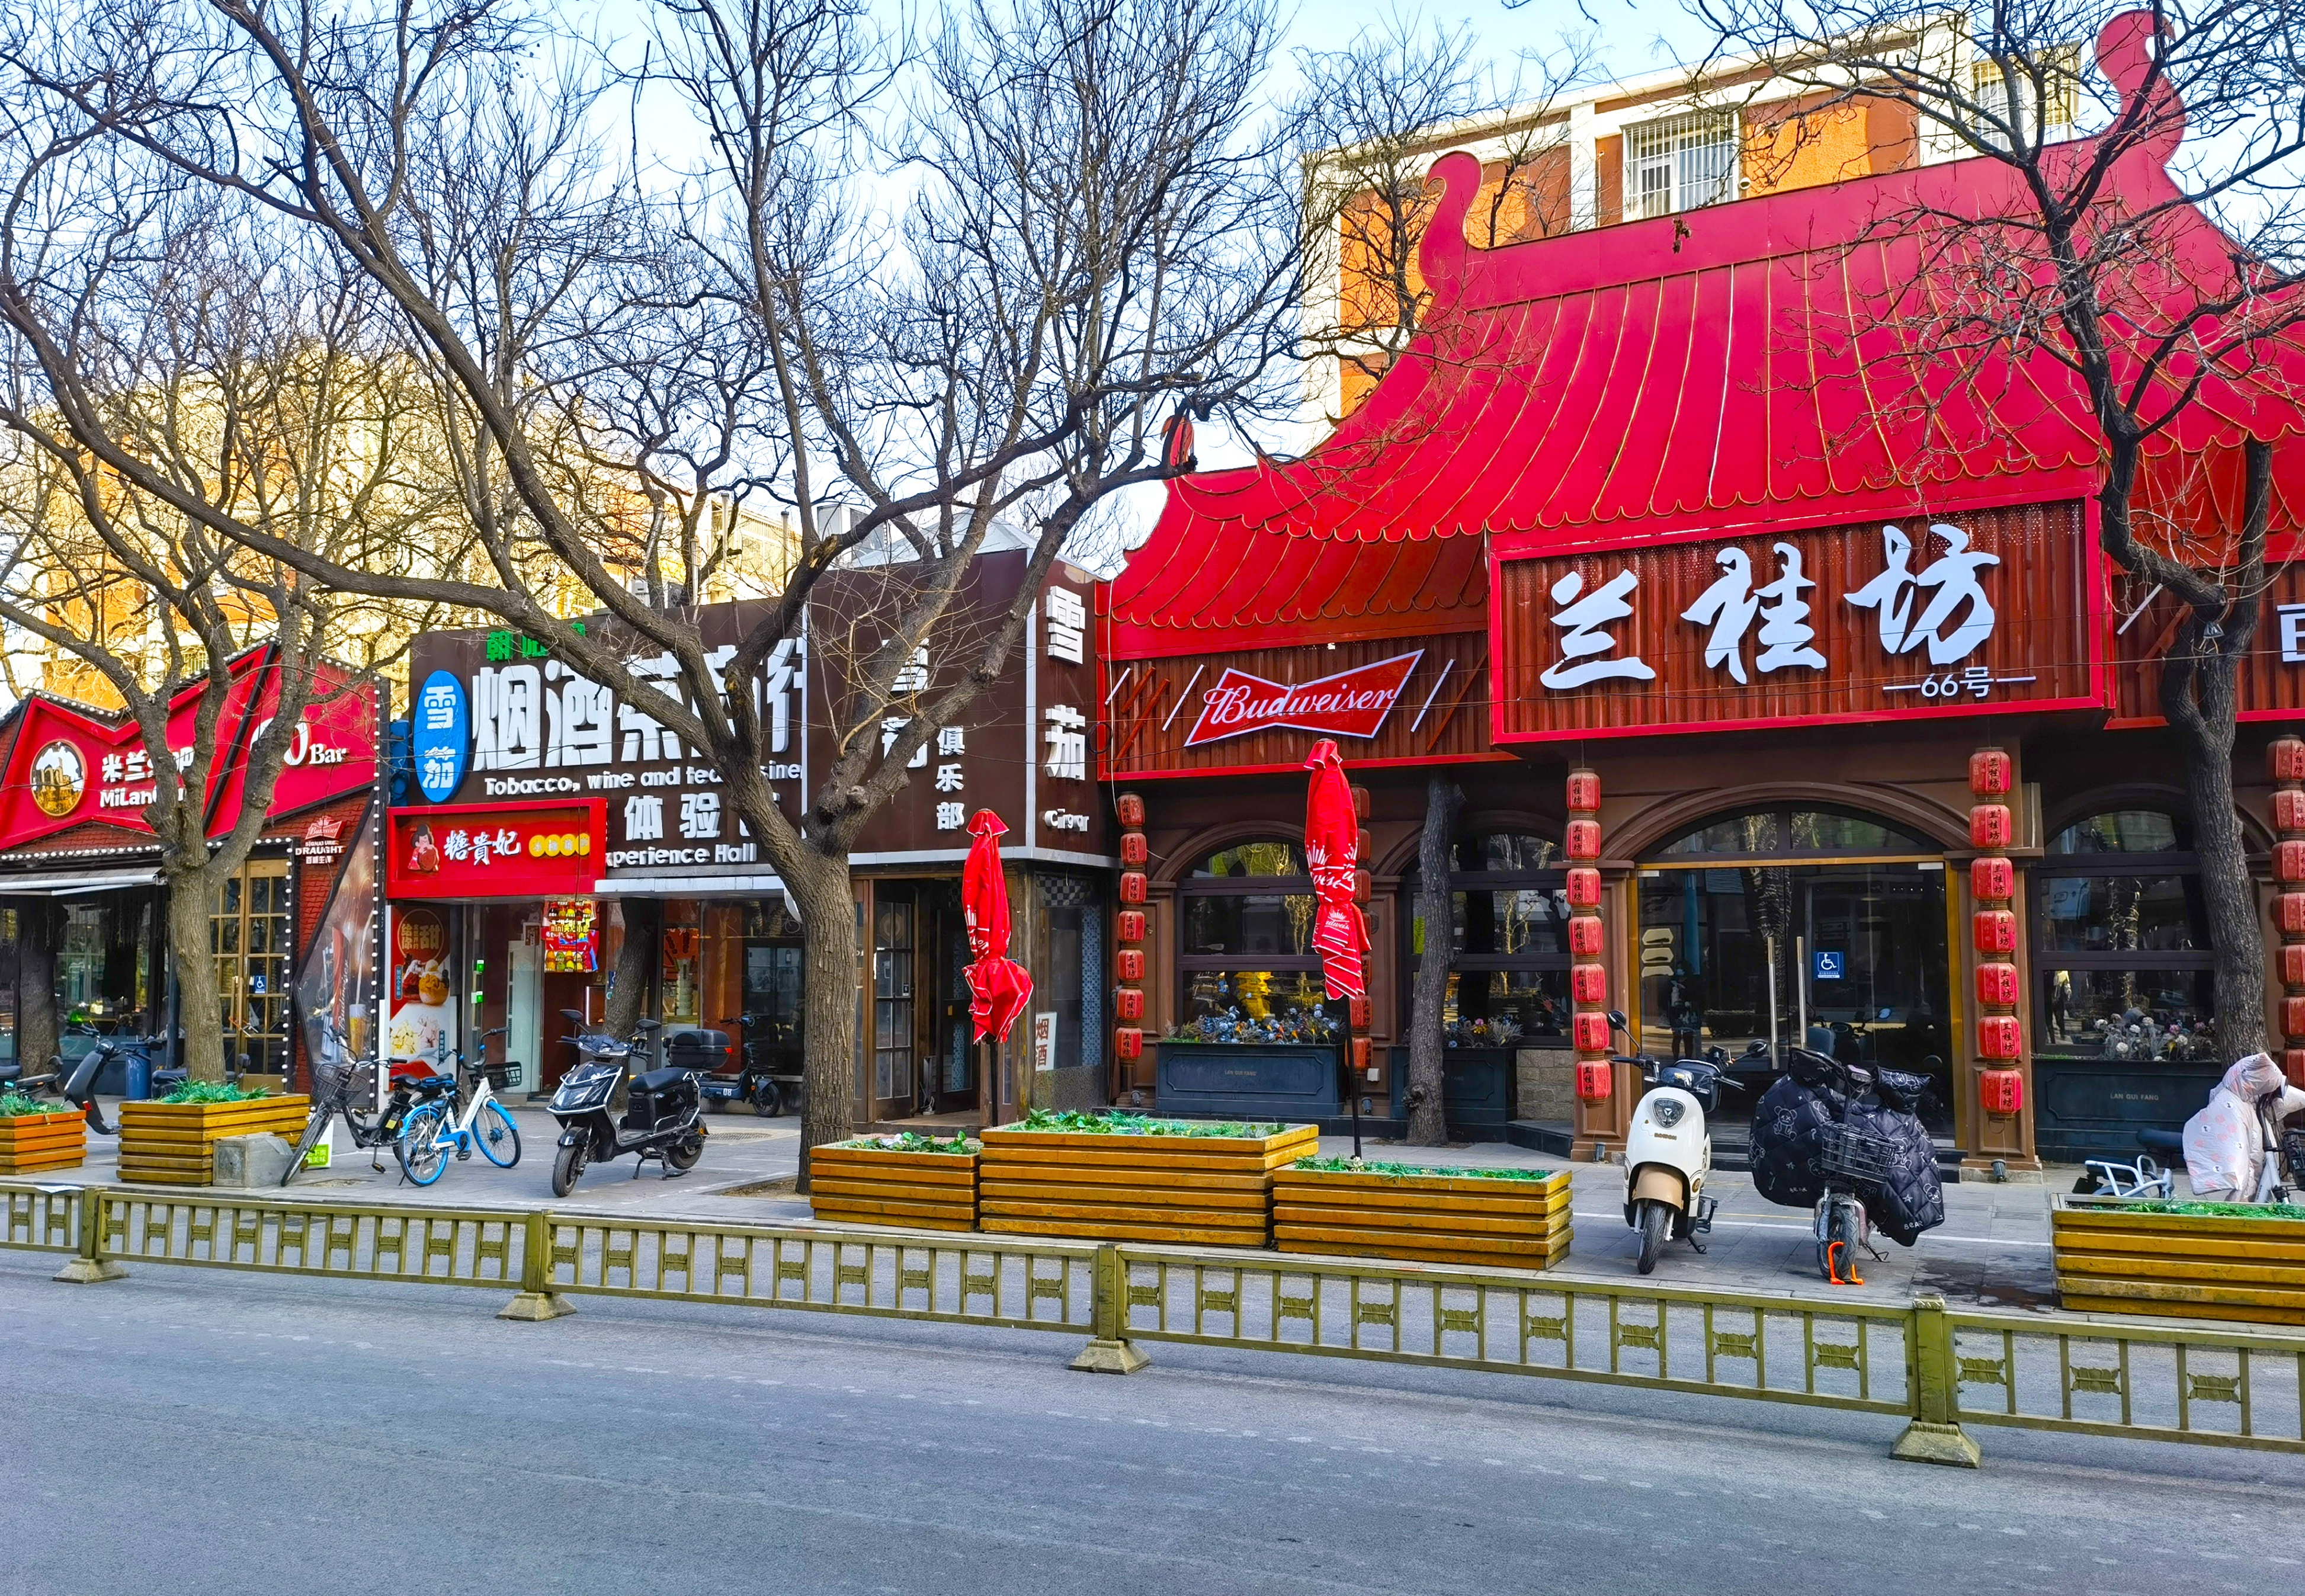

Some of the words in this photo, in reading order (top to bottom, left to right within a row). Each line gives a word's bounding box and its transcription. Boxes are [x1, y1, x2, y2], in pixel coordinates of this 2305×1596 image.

[1540, 524, 2001, 690] 兰桂坊
[1045, 586, 1086, 781] 雪茄
[1921, 666, 1992, 698] 66号
[1203, 683, 1396, 725] Budweiser
[309, 743, 348, 764] Bar
[423, 685, 456, 790] 雪茄
[485, 777, 581, 796] Tobacco,
[587, 770, 634, 789] wine
[640, 767, 681, 786] and
[936, 725, 965, 830] 俱乐部
[1044, 808, 1089, 832] Cigar
[295, 846, 344, 855] DRAUGHT
[605, 846, 711, 868] xperience
[715, 843, 757, 862] Hall
[1036, 1018, 1049, 1066] 烟酒
